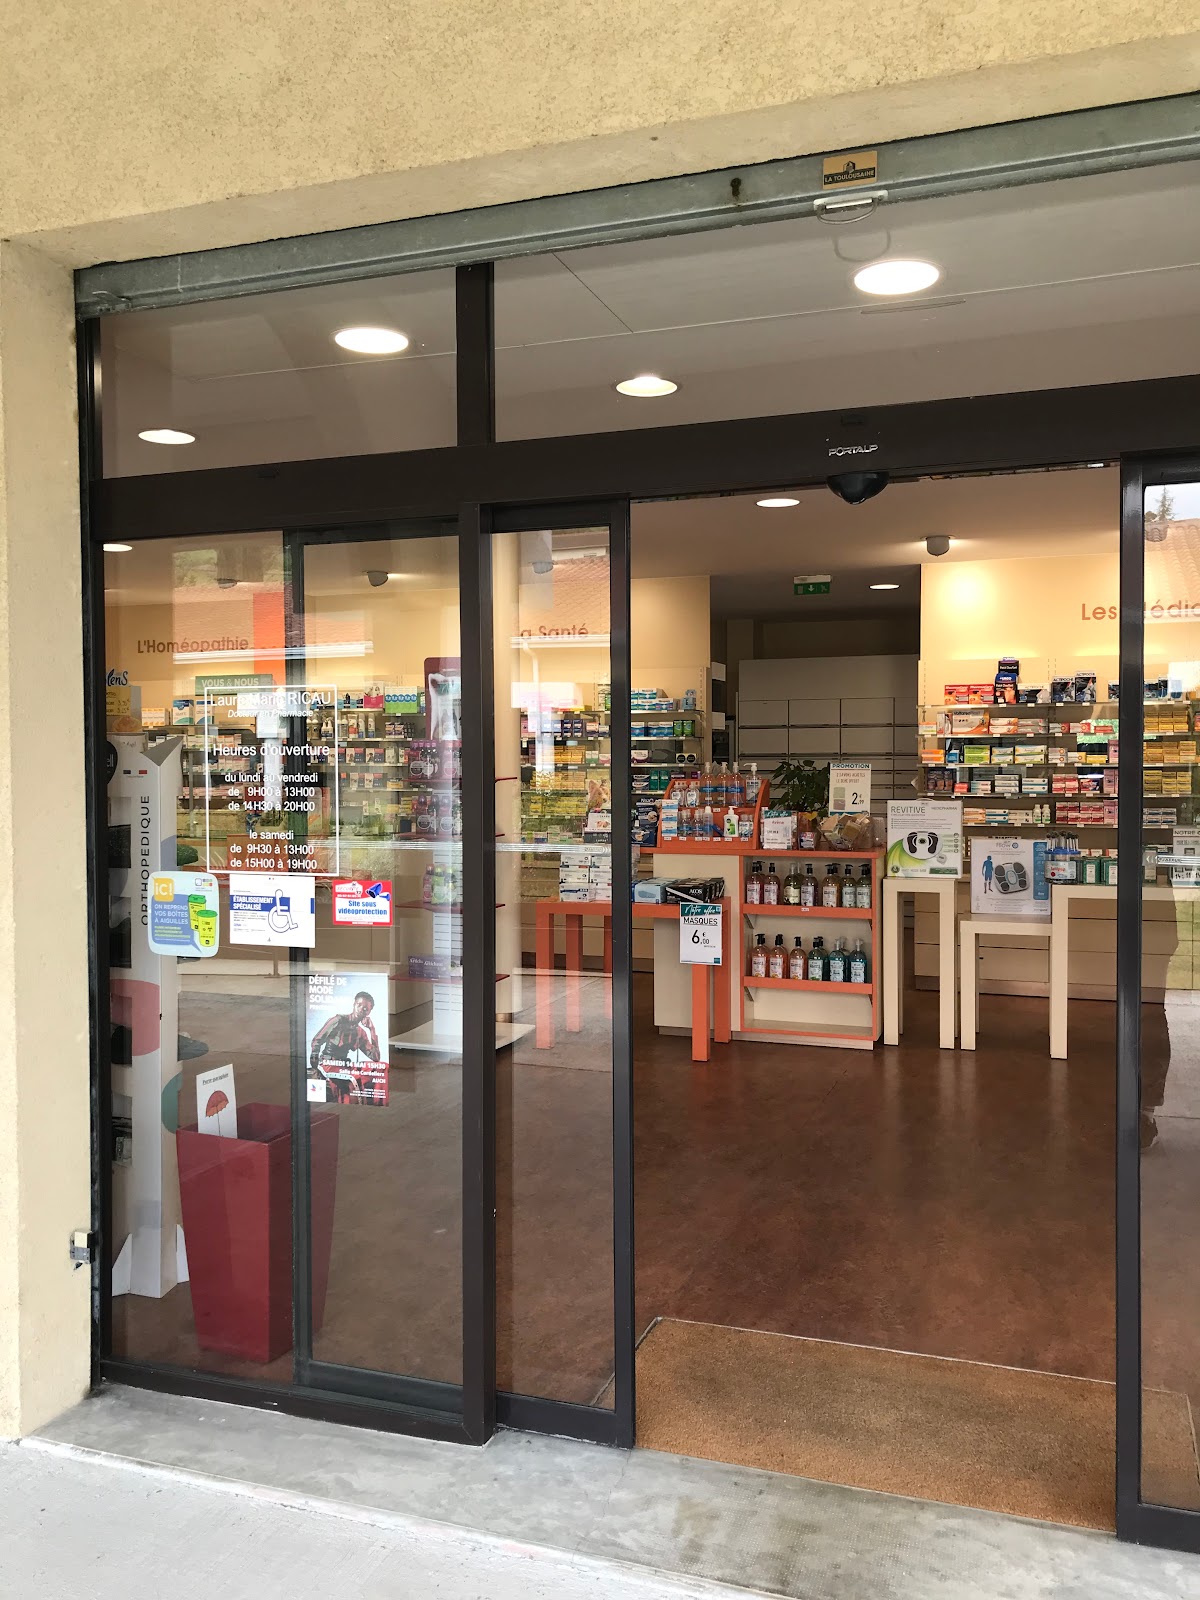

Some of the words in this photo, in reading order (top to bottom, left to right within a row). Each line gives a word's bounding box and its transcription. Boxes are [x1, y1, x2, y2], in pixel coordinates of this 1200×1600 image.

[834, 169, 874, 181] TOULOUSAINE
[828, 444, 878, 456] PORTALP
[1081, 603, 1118, 620] Les
[1144, 599, 1200, 619] édic
[538, 622, 588, 639] Santé
[137, 636, 249, 654] L'Homéopathie
[201, 679, 225, 688] VOUS
[226, 679, 235, 687] &
[235, 677, 259, 687] NOUS
[288, 691, 331, 705] RICAU
[213, 744, 257, 756] Heures
[260, 743, 331, 756] d'ouverture
[224, 773, 236, 782] du
[238, 772, 261, 782] lundi
[262, 774, 275, 782] au
[276, 772, 319, 782] vendredi
[228, 786, 240, 796] de
[247, 787, 273, 796] 9H00
[275, 787, 282, 796] à
[284, 787, 315, 797] 13H00
[228, 801, 240, 810] de
[243, 801, 273, 811] 14H30
[275, 801, 282, 811] à
[284, 801, 316, 811] 20H00
[890, 805, 926, 814] REVITIVE
[249, 830, 258, 839] le
[260, 830, 294, 840] samedi
[230, 844, 242, 853] de
[247, 844, 272, 853] 9H30
[274, 844, 281, 854] à
[283, 844, 314, 855] 13H00
[140, 796, 151, 925] ORTHOPEDIQUE
[230, 858, 242, 867] de
[245, 858, 275, 868] 15H00
[277, 858, 284, 868] à
[287, 859, 318, 869] 19H00
[683, 916, 718, 925] MASQUES
[308, 973, 335, 986] DÉFILÉ
[336, 976, 348, 986] DE
[308, 984, 334, 995] MODE
[322, 1059, 346, 1068] SAMEDI
